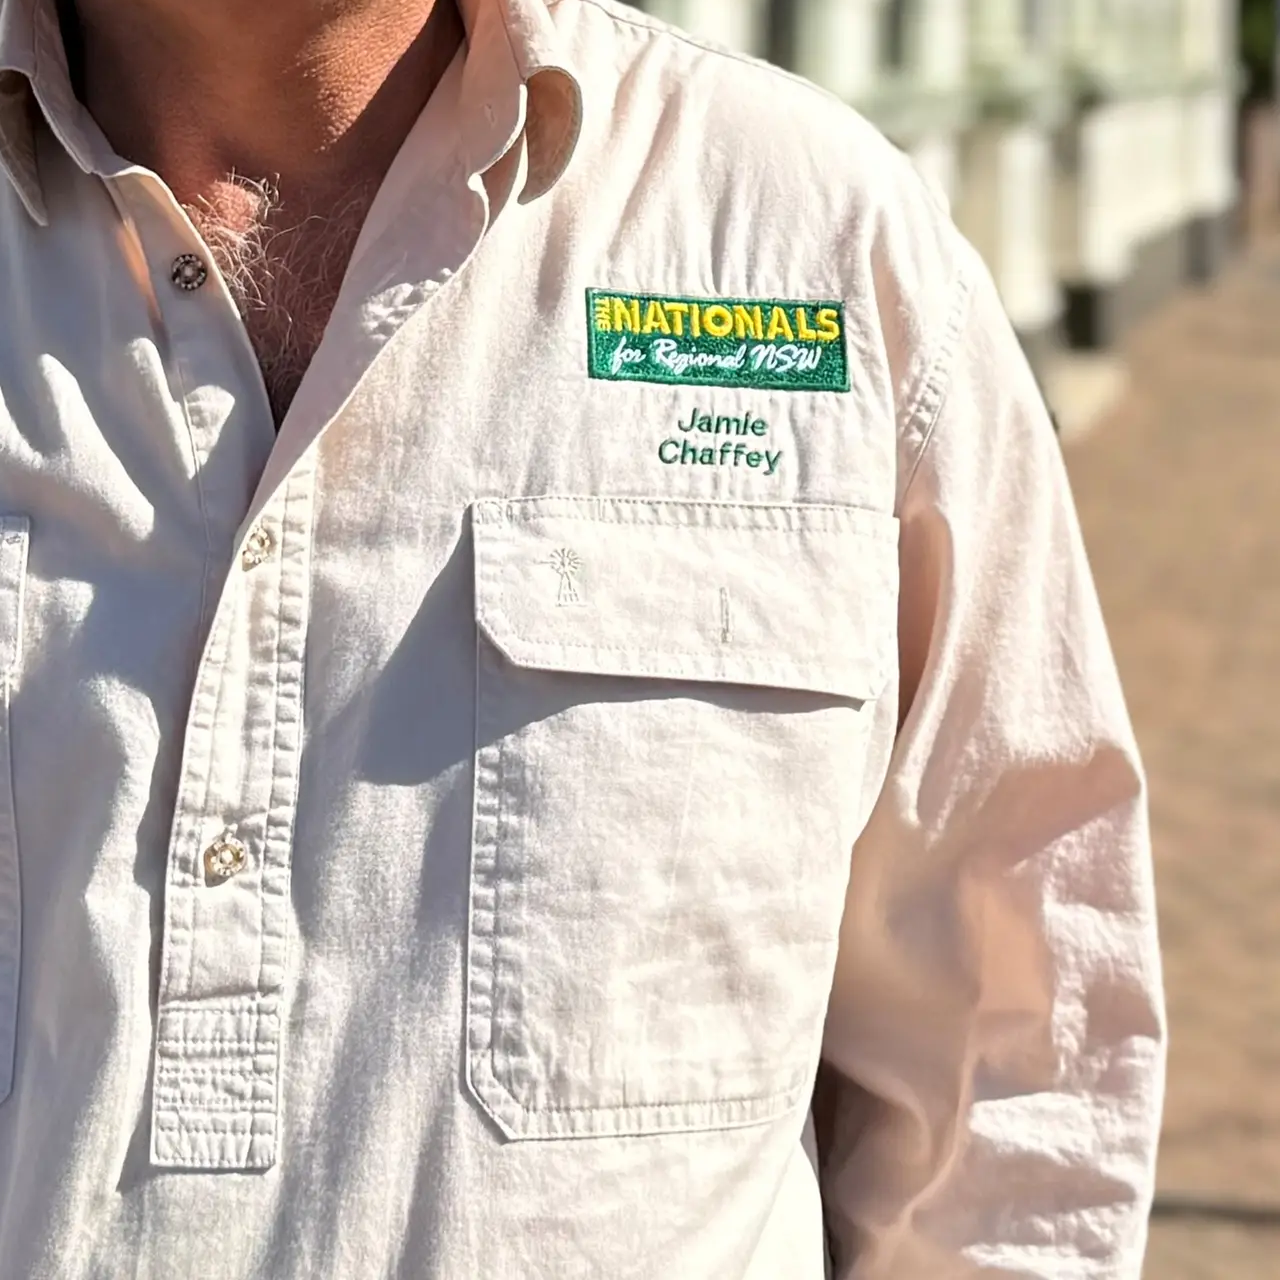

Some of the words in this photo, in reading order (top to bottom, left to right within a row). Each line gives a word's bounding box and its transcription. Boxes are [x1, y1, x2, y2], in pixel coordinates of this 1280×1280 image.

[594, 297, 611, 332] THE
[613, 297, 840, 341] NATIONALS
[611, 336, 646, 374] for
[653, 338, 747, 375] Regional
[747, 343, 821, 370] NSW
[677, 407, 767, 436] Jamie
[658, 440, 782, 475] Chaffey
